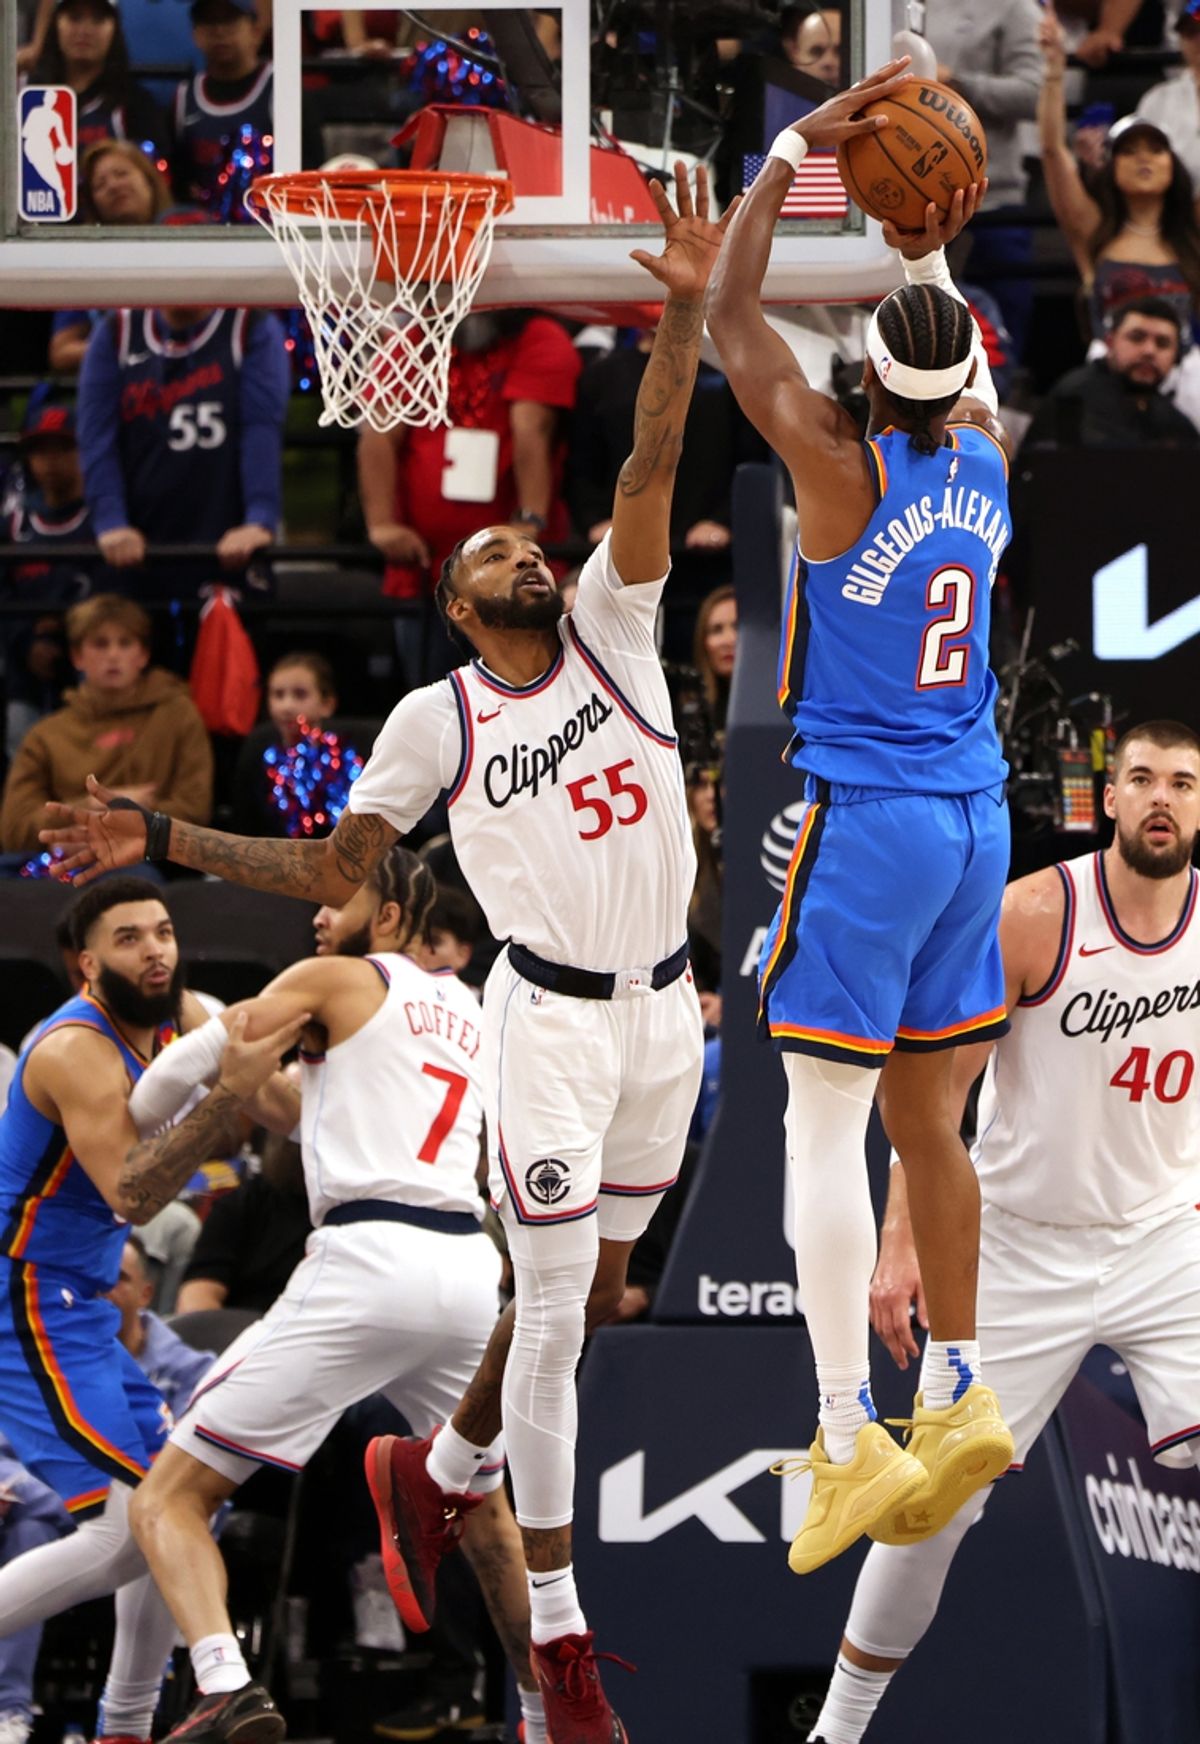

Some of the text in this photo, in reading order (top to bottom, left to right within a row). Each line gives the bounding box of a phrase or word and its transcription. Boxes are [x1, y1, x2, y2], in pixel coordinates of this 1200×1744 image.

[918, 87, 984, 171] Wilson
[27, 190, 55, 212] NBA
[168, 402, 227, 451] 55
[842, 487, 1008, 606] GILGEOUS-ALEXAN
[915, 563, 976, 692] 2
[484, 693, 613, 808] Clippers
[565, 758, 648, 841] 55
[417, 1062, 468, 1165] 7
[1109, 1046, 1195, 1104] 40
[698, 1274, 805, 1316] tera
[599, 1449, 815, 1542] KI
